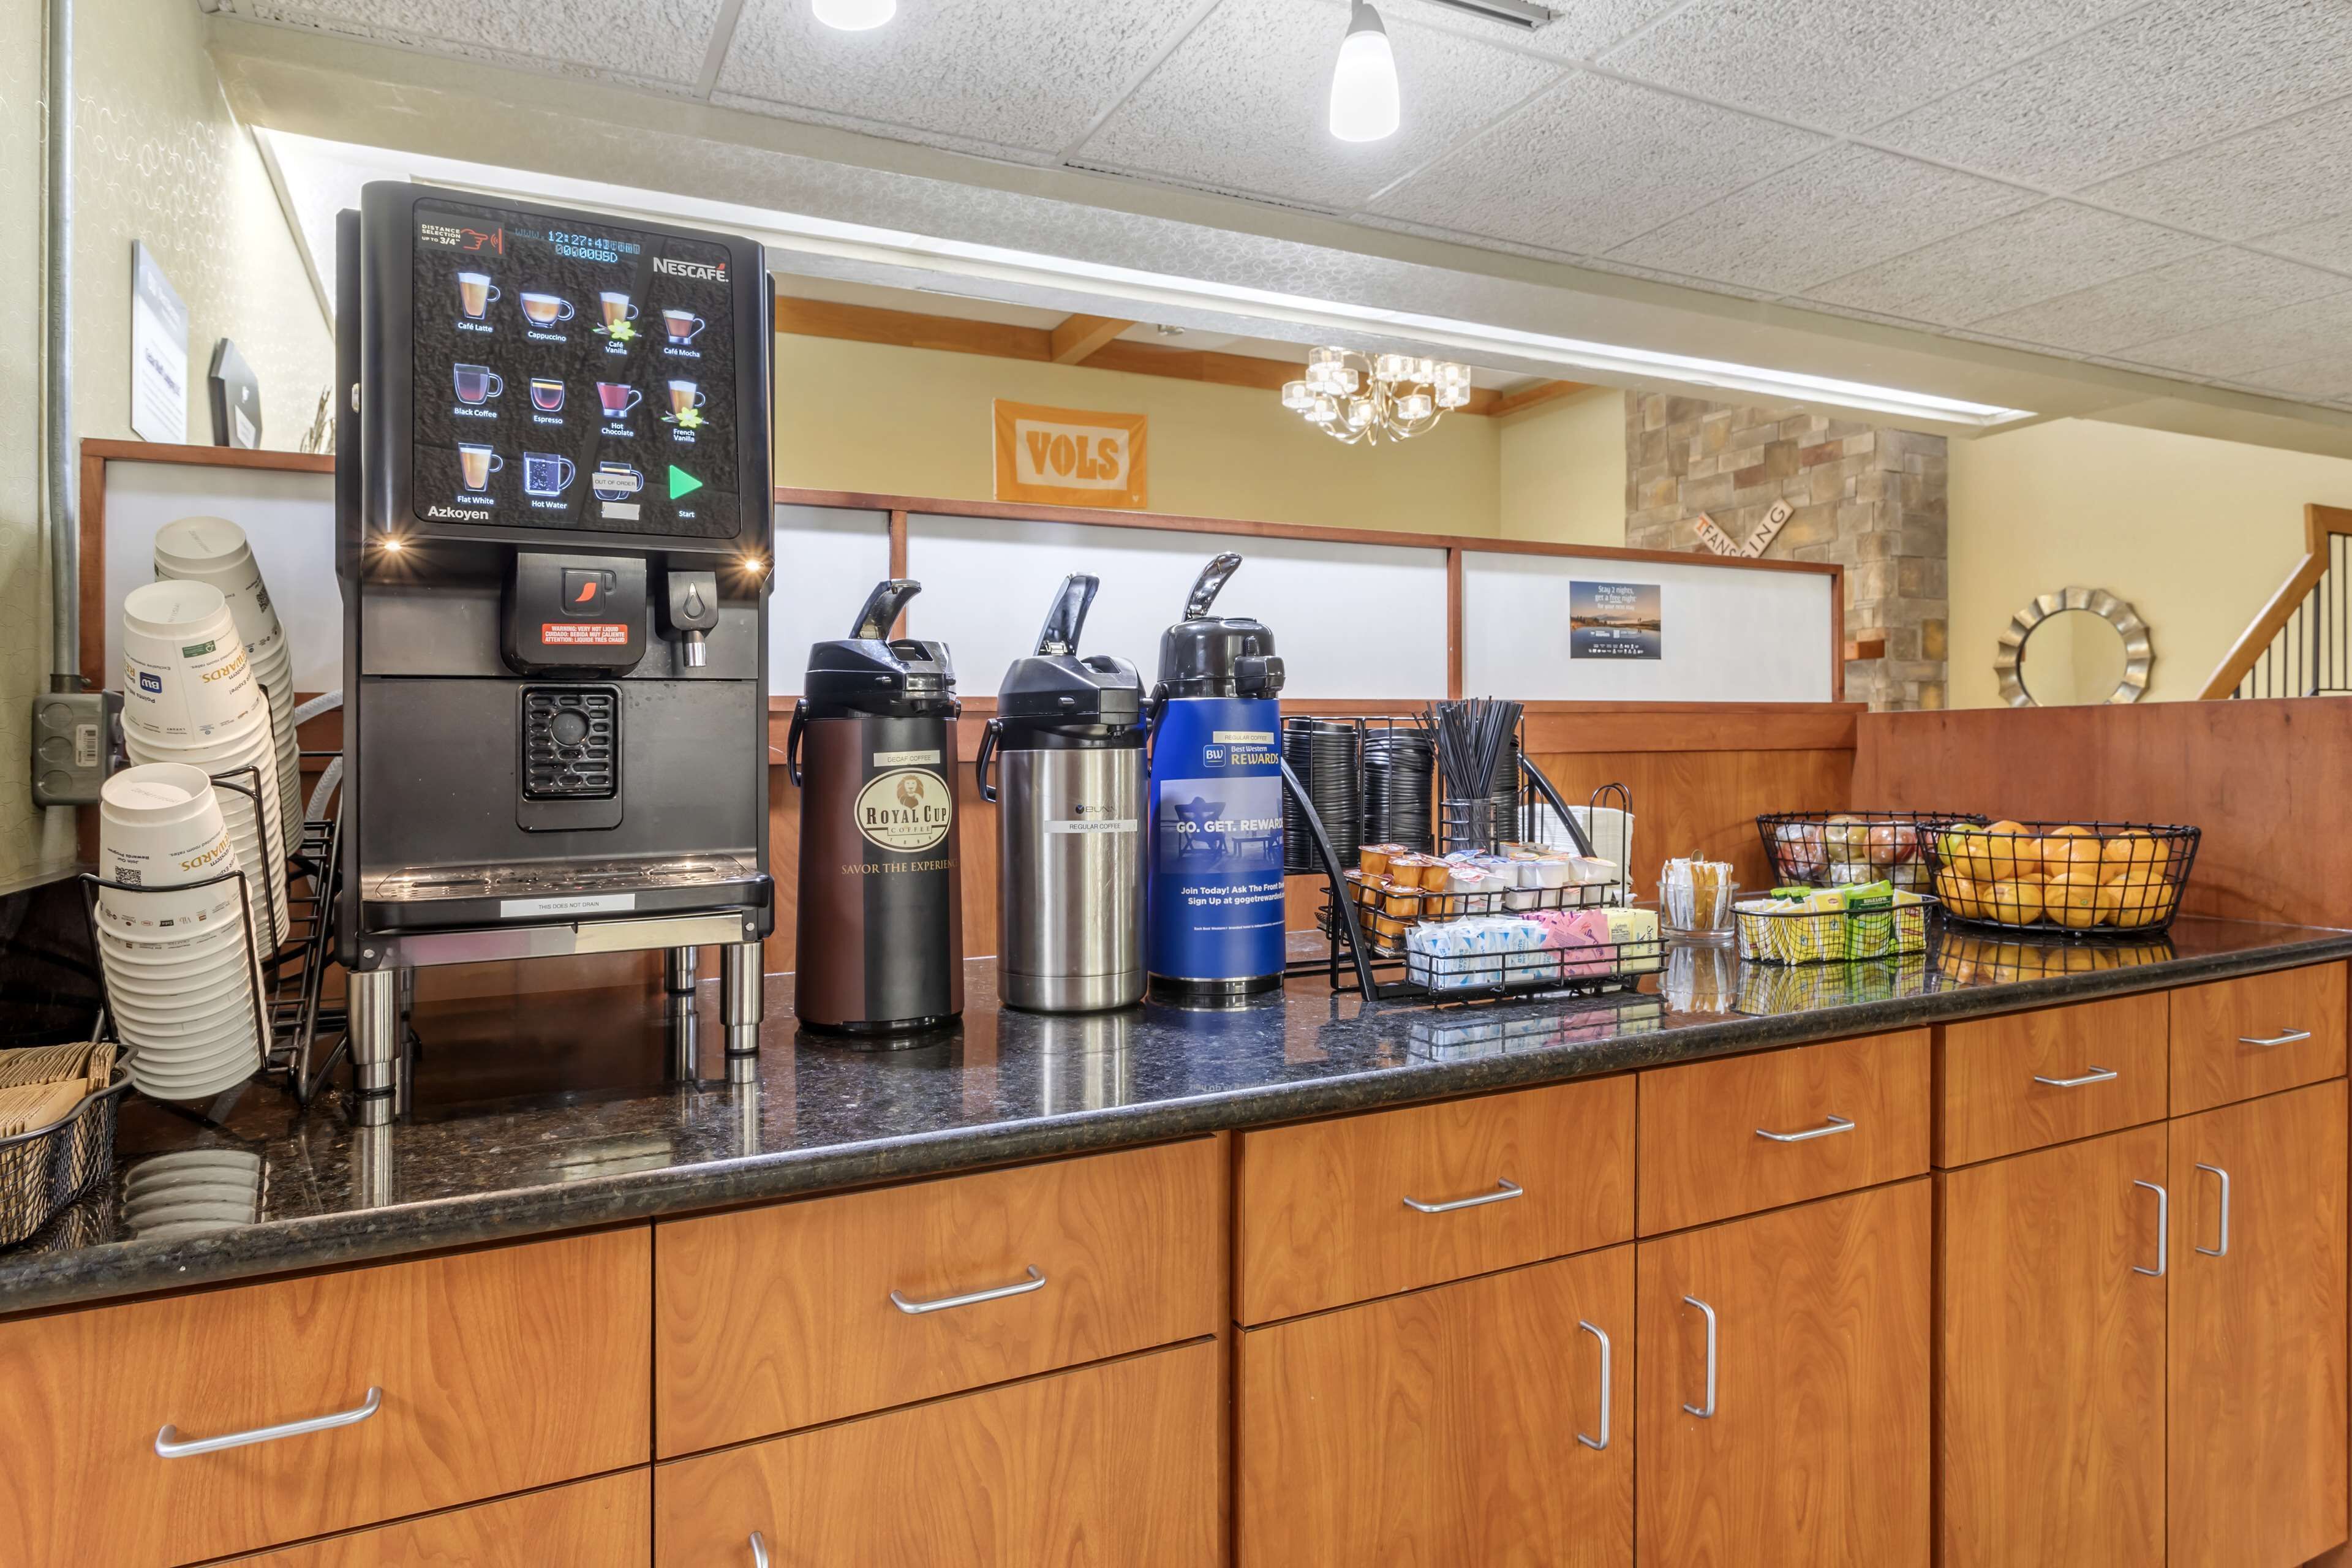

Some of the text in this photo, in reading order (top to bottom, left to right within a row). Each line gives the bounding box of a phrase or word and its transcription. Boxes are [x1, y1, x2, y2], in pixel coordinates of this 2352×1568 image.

[421, 224, 460, 233] DISTANCE
[421, 228, 461, 239] SELECTION
[527, 331, 567, 342] Cappuccino
[533, 415, 563, 424] Espresso
[601, 428, 634, 437] Chocolate
[1026, 431, 1119, 480] VOLS
[428, 505, 489, 521] Azkoyen
[1598, 586, 1610, 594] Stay
[1610, 594, 1622, 603] free
[142, 679, 159, 690] BW
[137, 693, 156, 704] Points
[1206, 750, 1223, 759] BW
[1231, 753, 1279, 765] REWARDS
[866, 805, 946, 824] ROYAL CUP
[1176, 821, 1200, 833] GO.
[1204, 820, 1236, 832] GET.
[842, 864, 880, 875] SAVOR
[883, 862, 907, 873] THE
[1200, 886, 1229, 895] Today!
[1264, 883, 1278, 891] Front
[1188, 897, 1207, 906] Sign
[1209, 897, 1221, 906] Up
